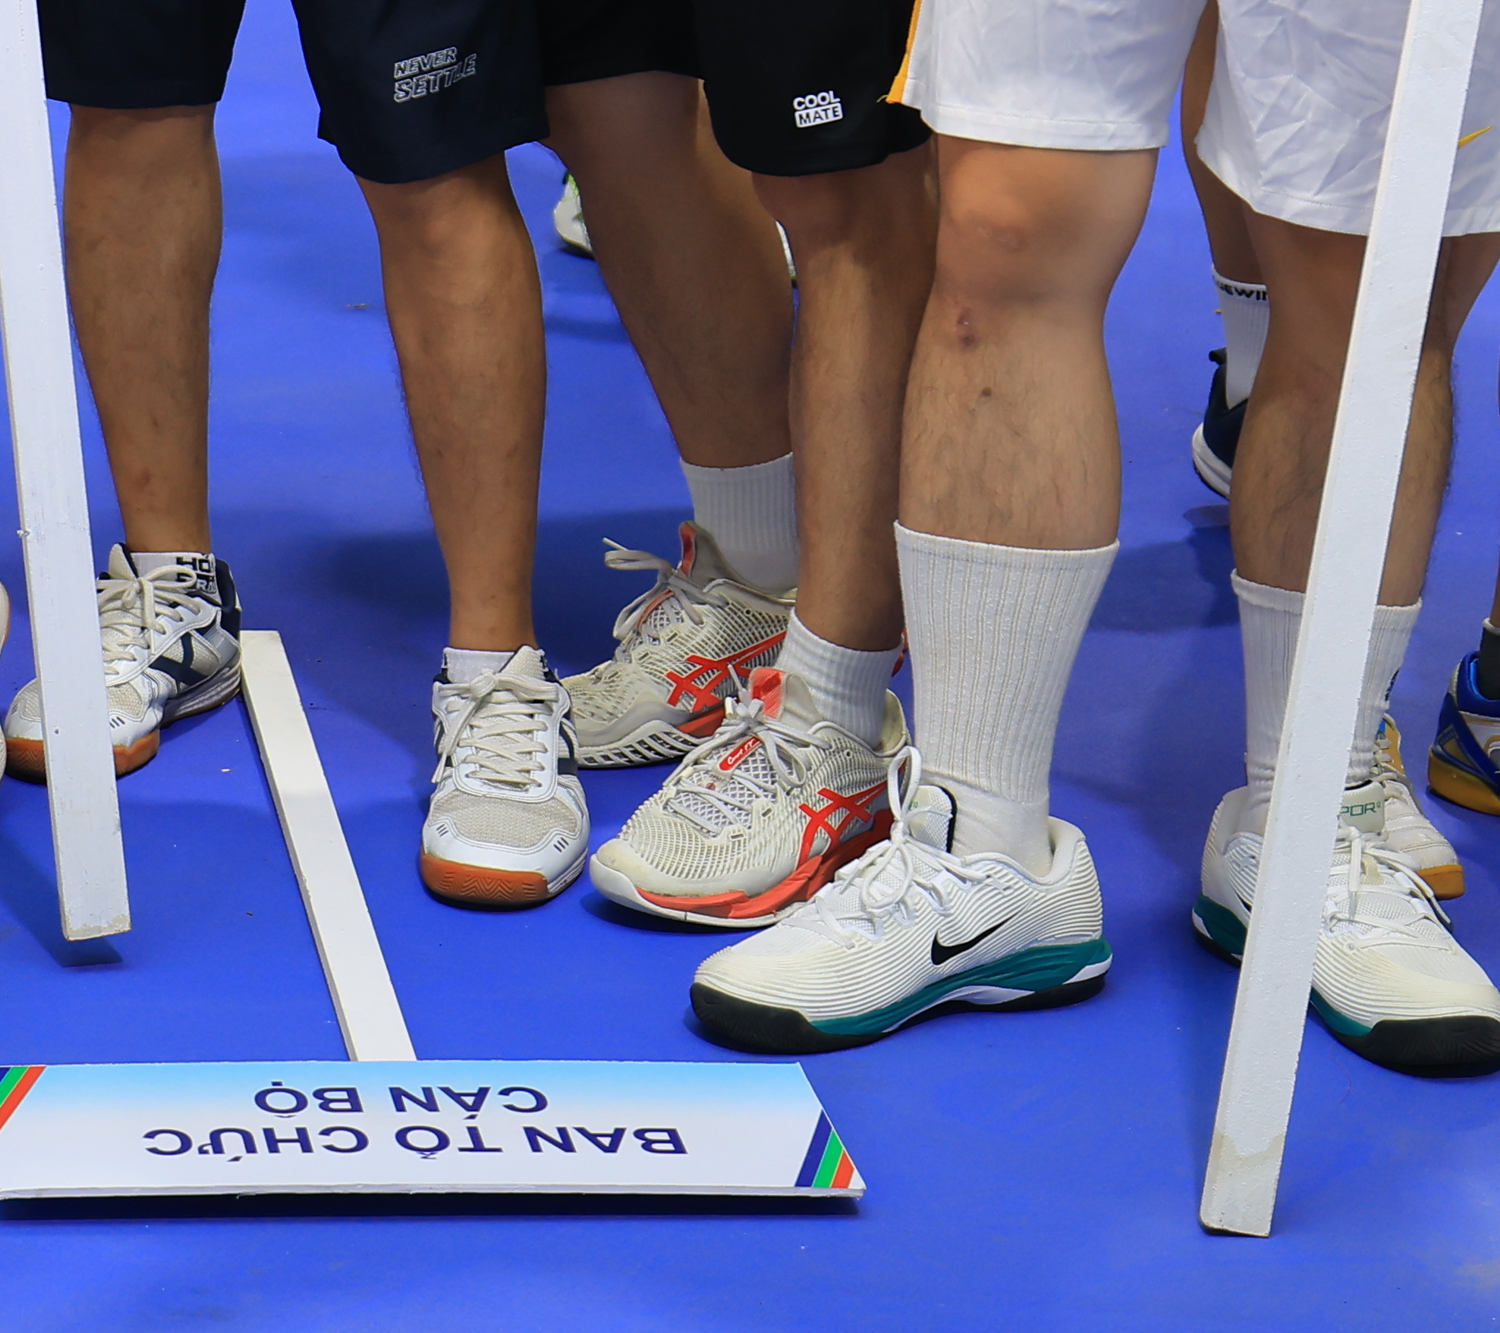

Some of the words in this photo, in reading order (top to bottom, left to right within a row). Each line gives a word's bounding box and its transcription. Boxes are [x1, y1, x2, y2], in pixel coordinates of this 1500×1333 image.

[394, 46, 457, 79] NEVER
[394, 53, 476, 103] SETTLE
[793, 90, 841, 110] COOL
[798, 105, 841, 126] MATE
[254, 1080, 364, 1121] BỘ
[390, 1085, 548, 1121] CÁN
[144, 1126, 368, 1162] CHỨC
[395, 1126, 503, 1160] TỔ
[512, 1126, 688, 1156] BAN
